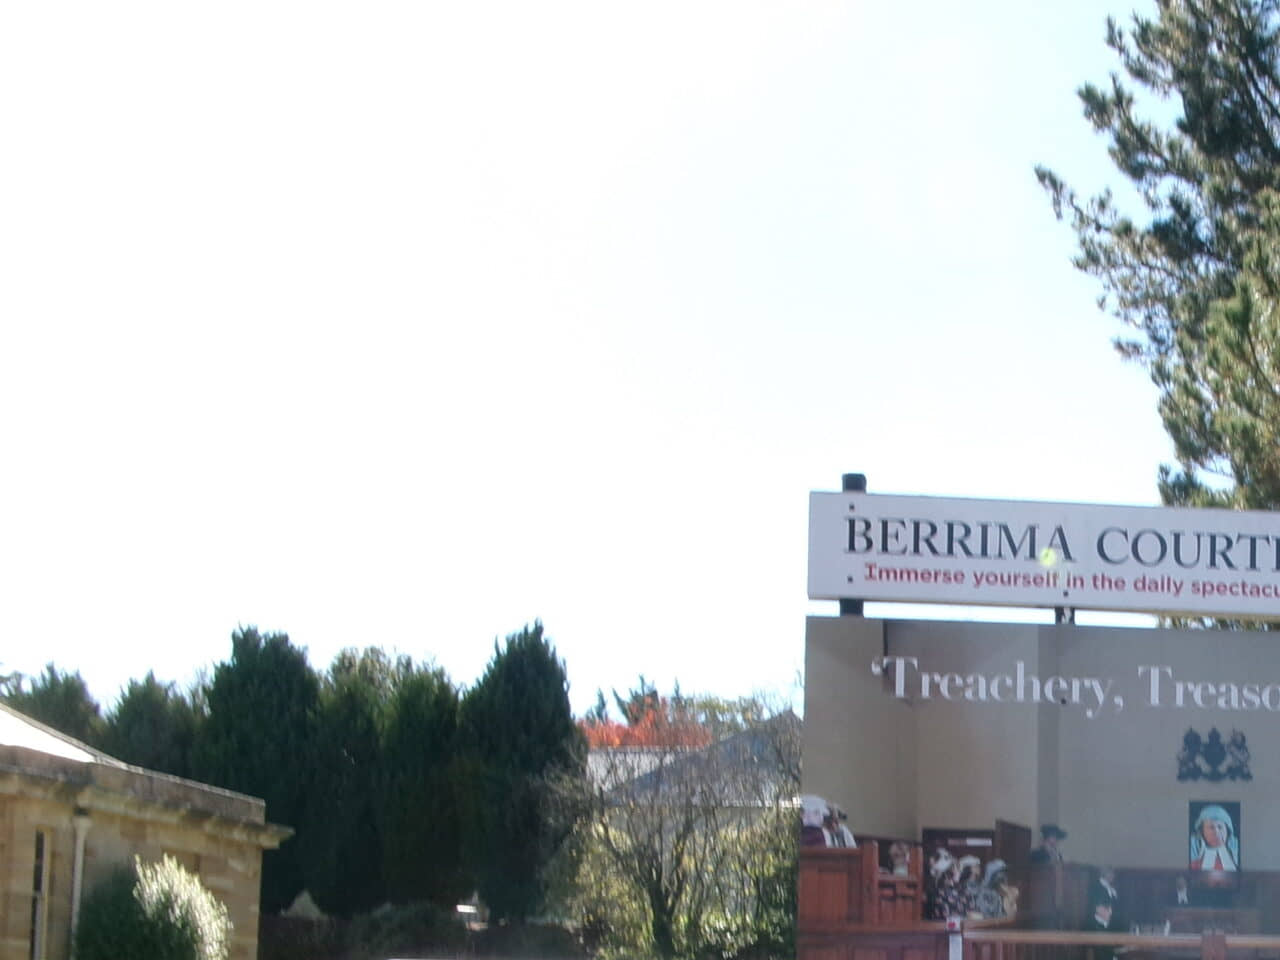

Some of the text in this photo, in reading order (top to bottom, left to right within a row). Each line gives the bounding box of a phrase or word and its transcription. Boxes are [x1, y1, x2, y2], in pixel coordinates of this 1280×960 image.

[844, 515, 1077, 563] BERRIMA
[864, 562, 965, 584] Immerse
[972, 569, 1060, 589] yourself
[1066, 572, 1085, 590] in
[1092, 573, 1126, 592] the
[1133, 574, 1184, 597] daily
